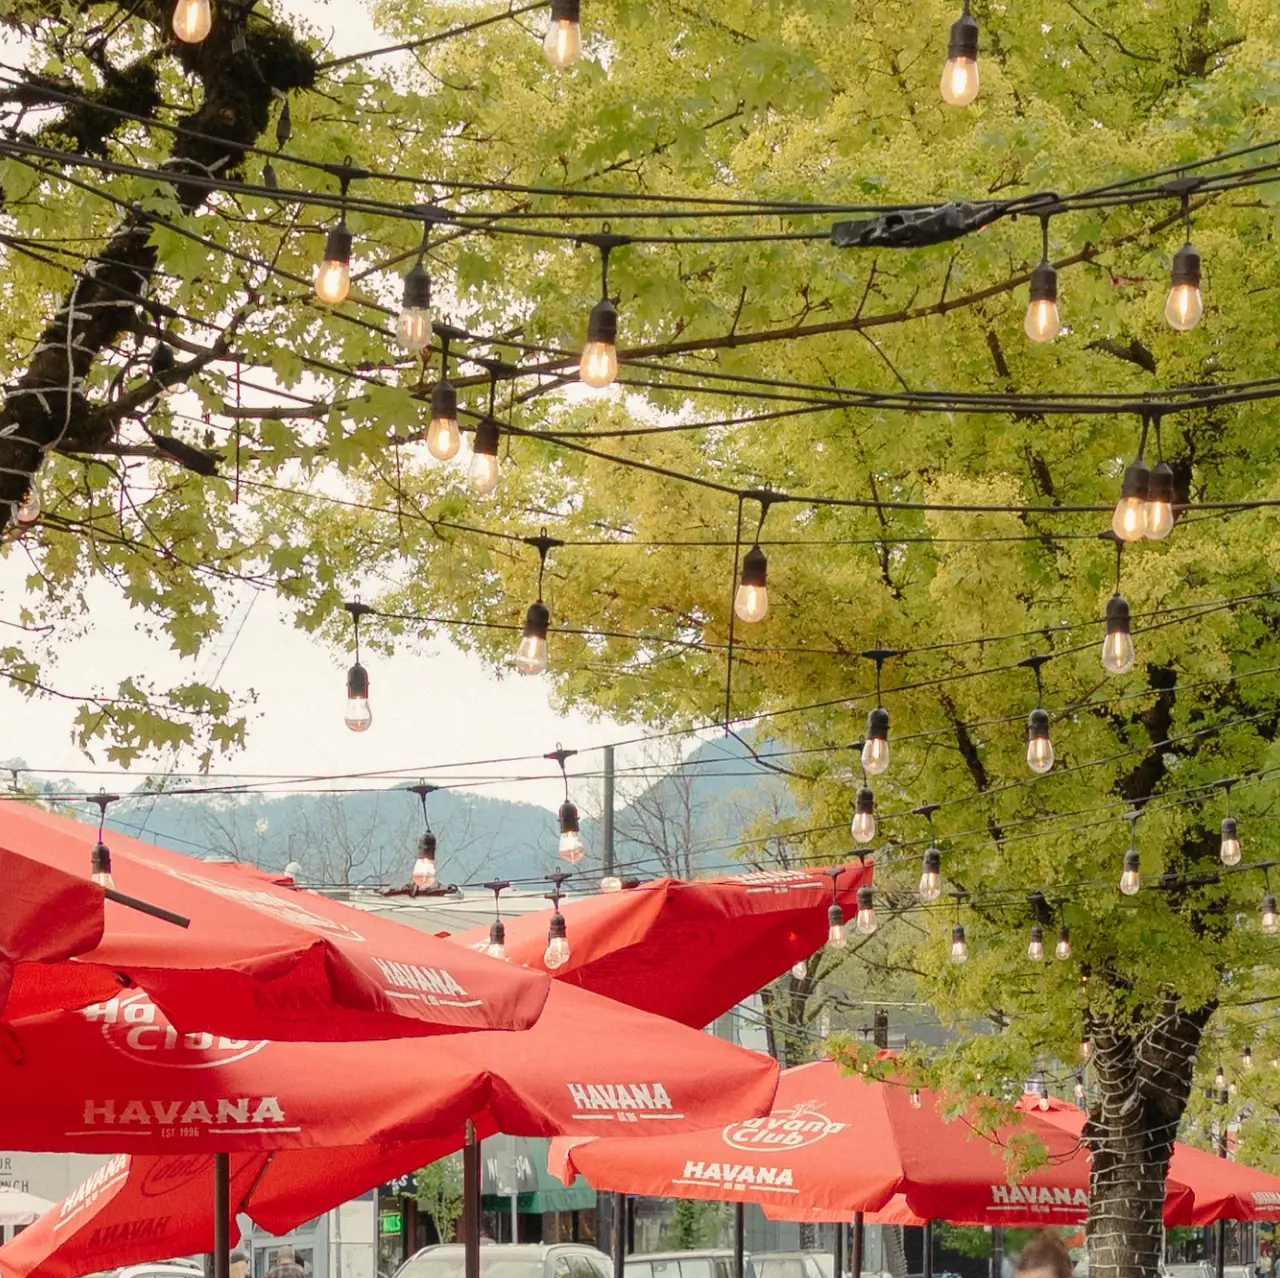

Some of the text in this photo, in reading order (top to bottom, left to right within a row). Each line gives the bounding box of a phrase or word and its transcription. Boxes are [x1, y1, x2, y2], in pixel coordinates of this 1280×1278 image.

[371, 957, 468, 997] HAVANA
[566, 1082, 674, 1111] HAVANA
[81, 1097, 286, 1125] HAVANA
[732, 1127, 804, 1146] Club
[742, 1116, 848, 1134] avana
[59, 1154, 127, 1218] HAVANA
[682, 1160, 794, 1186] HAVANA
[990, 1185, 1088, 1206] HAVANA
